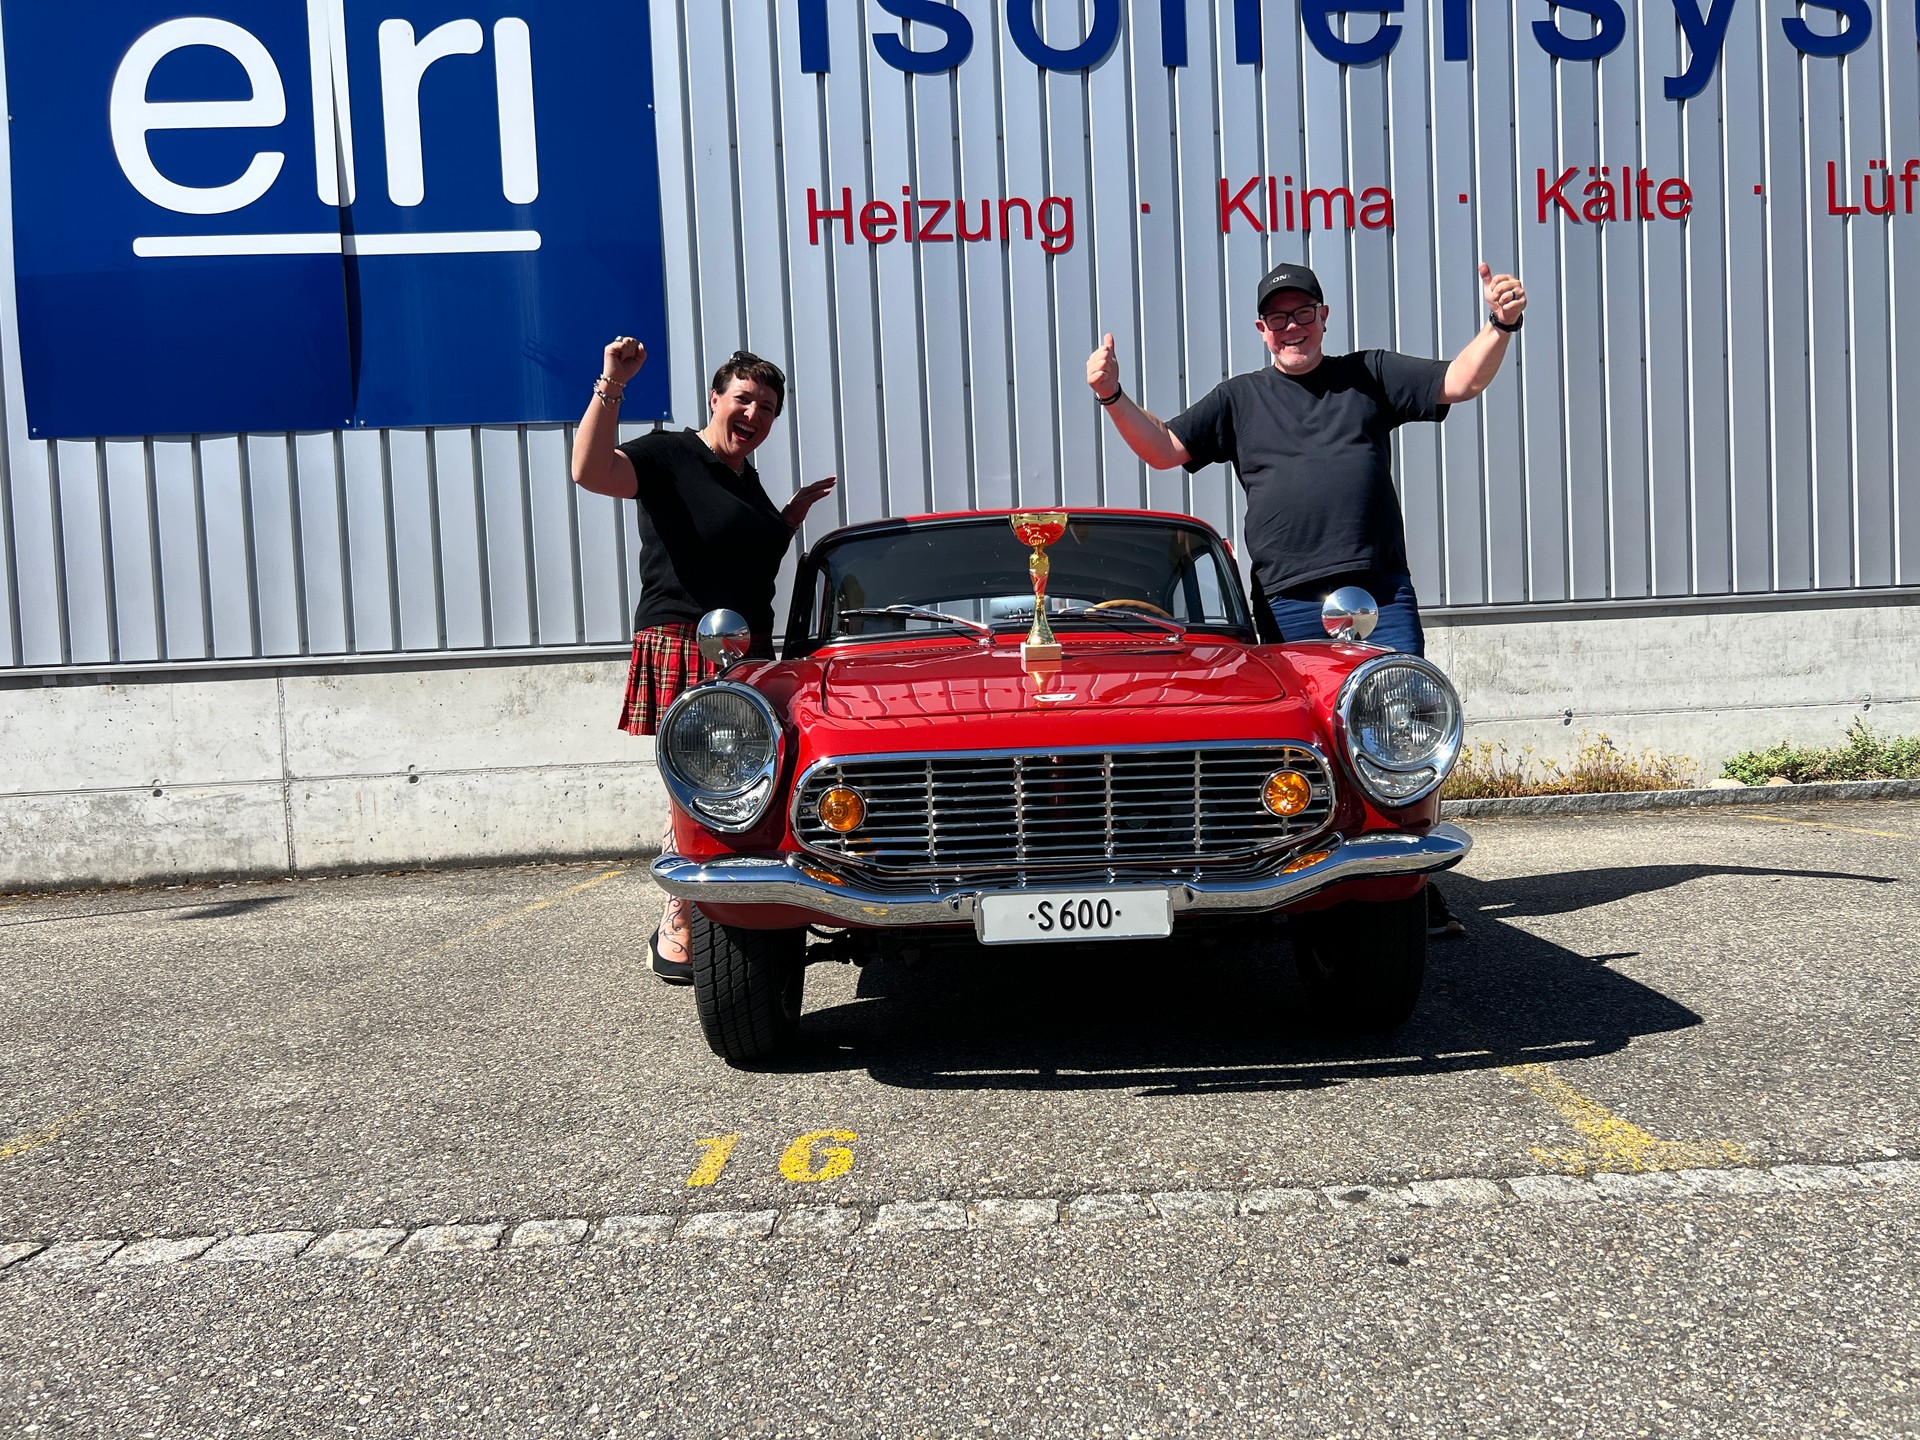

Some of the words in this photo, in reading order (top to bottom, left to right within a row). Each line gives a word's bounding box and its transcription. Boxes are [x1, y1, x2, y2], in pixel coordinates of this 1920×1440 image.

[806, 186, 1074, 254] Heizung
[1219, 175, 1394, 233] Klima
[1536, 166, 1693, 223] Kälte
[1827, 159, 1920, 215] Lüf
[687, 1129, 858, 1187] 16
